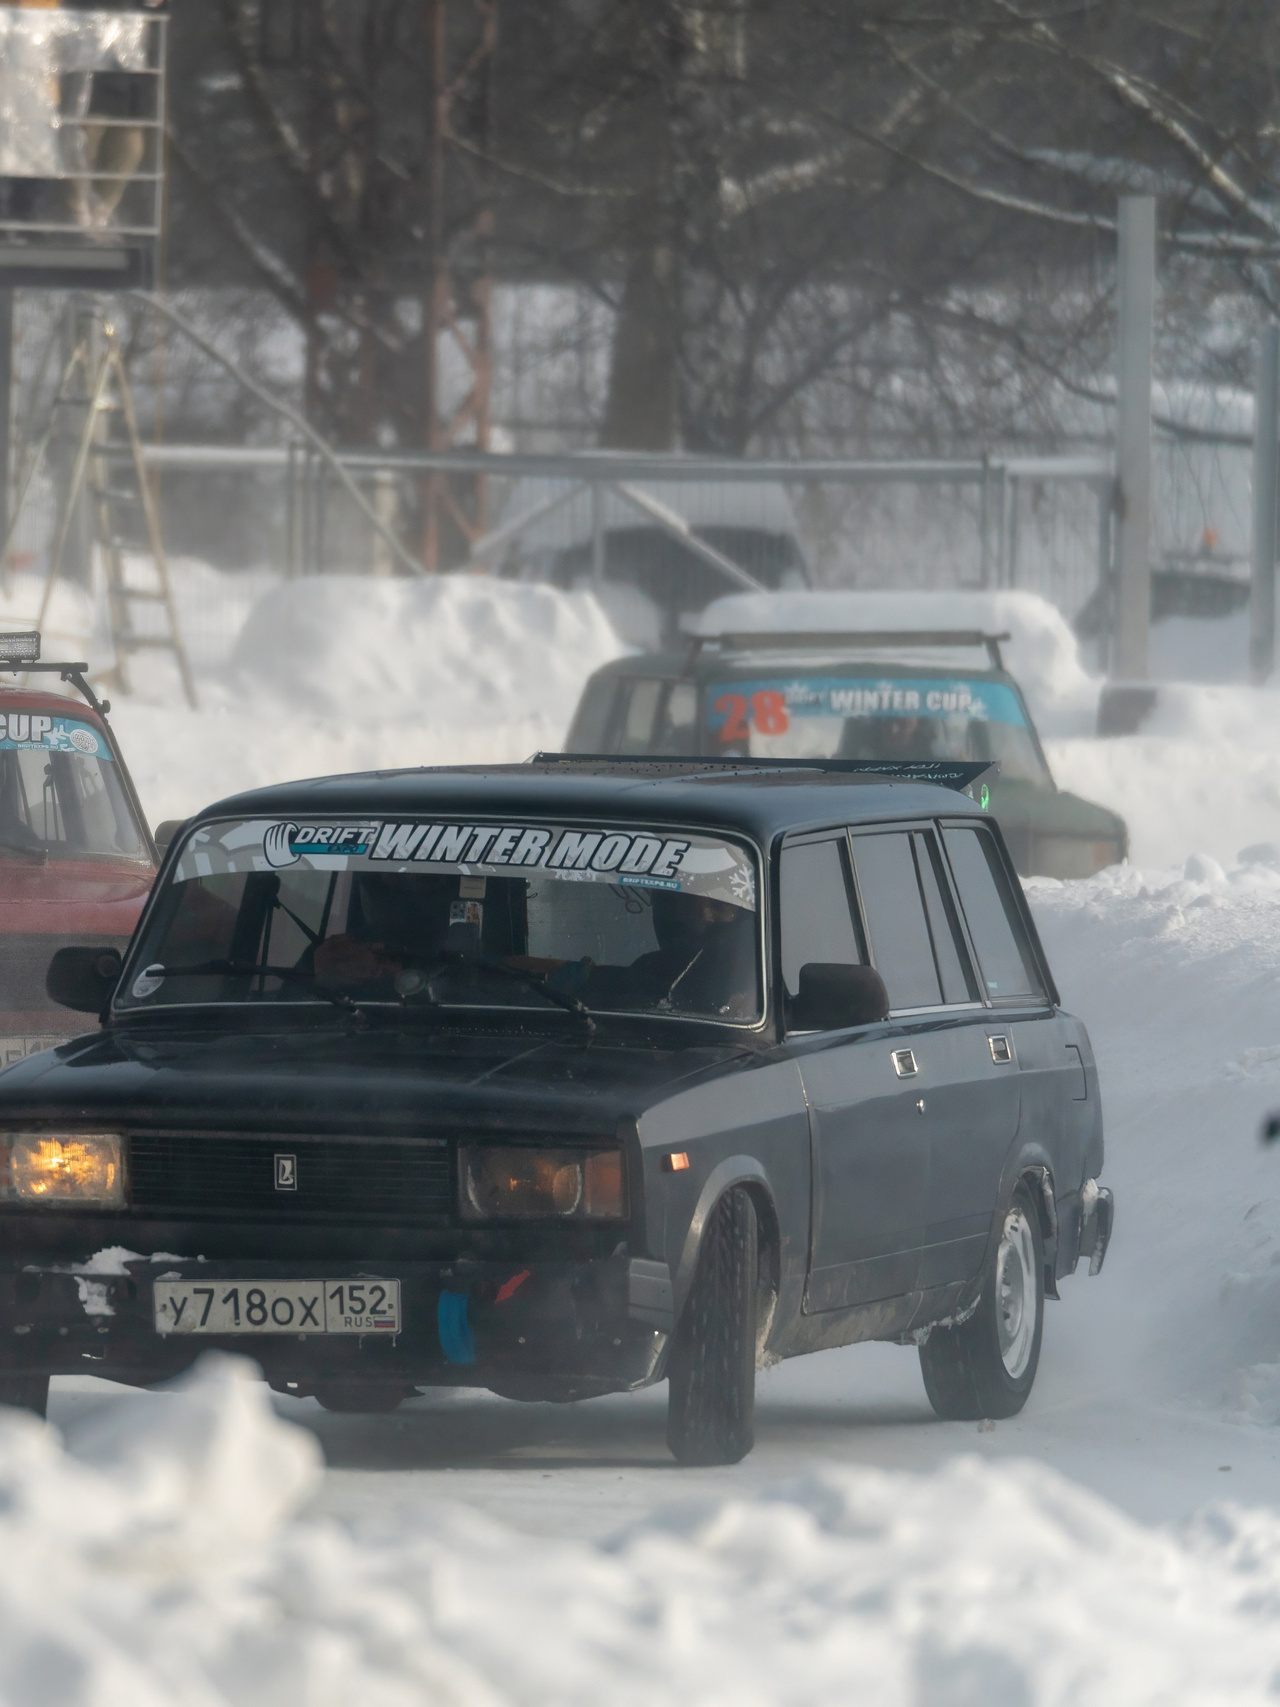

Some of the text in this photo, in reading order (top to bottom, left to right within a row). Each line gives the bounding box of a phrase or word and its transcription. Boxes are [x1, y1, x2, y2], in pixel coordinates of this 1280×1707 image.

[830, 690, 920, 711] WINTER
[926, 690, 973, 711] CUP
[714, 690, 789, 742] 28
[295, 826, 376, 845] DRIFT
[370, 823, 690, 877] WINTER MODE
[329, 1285, 387, 1316] 152
[344, 1316, 373, 1328] RUS
